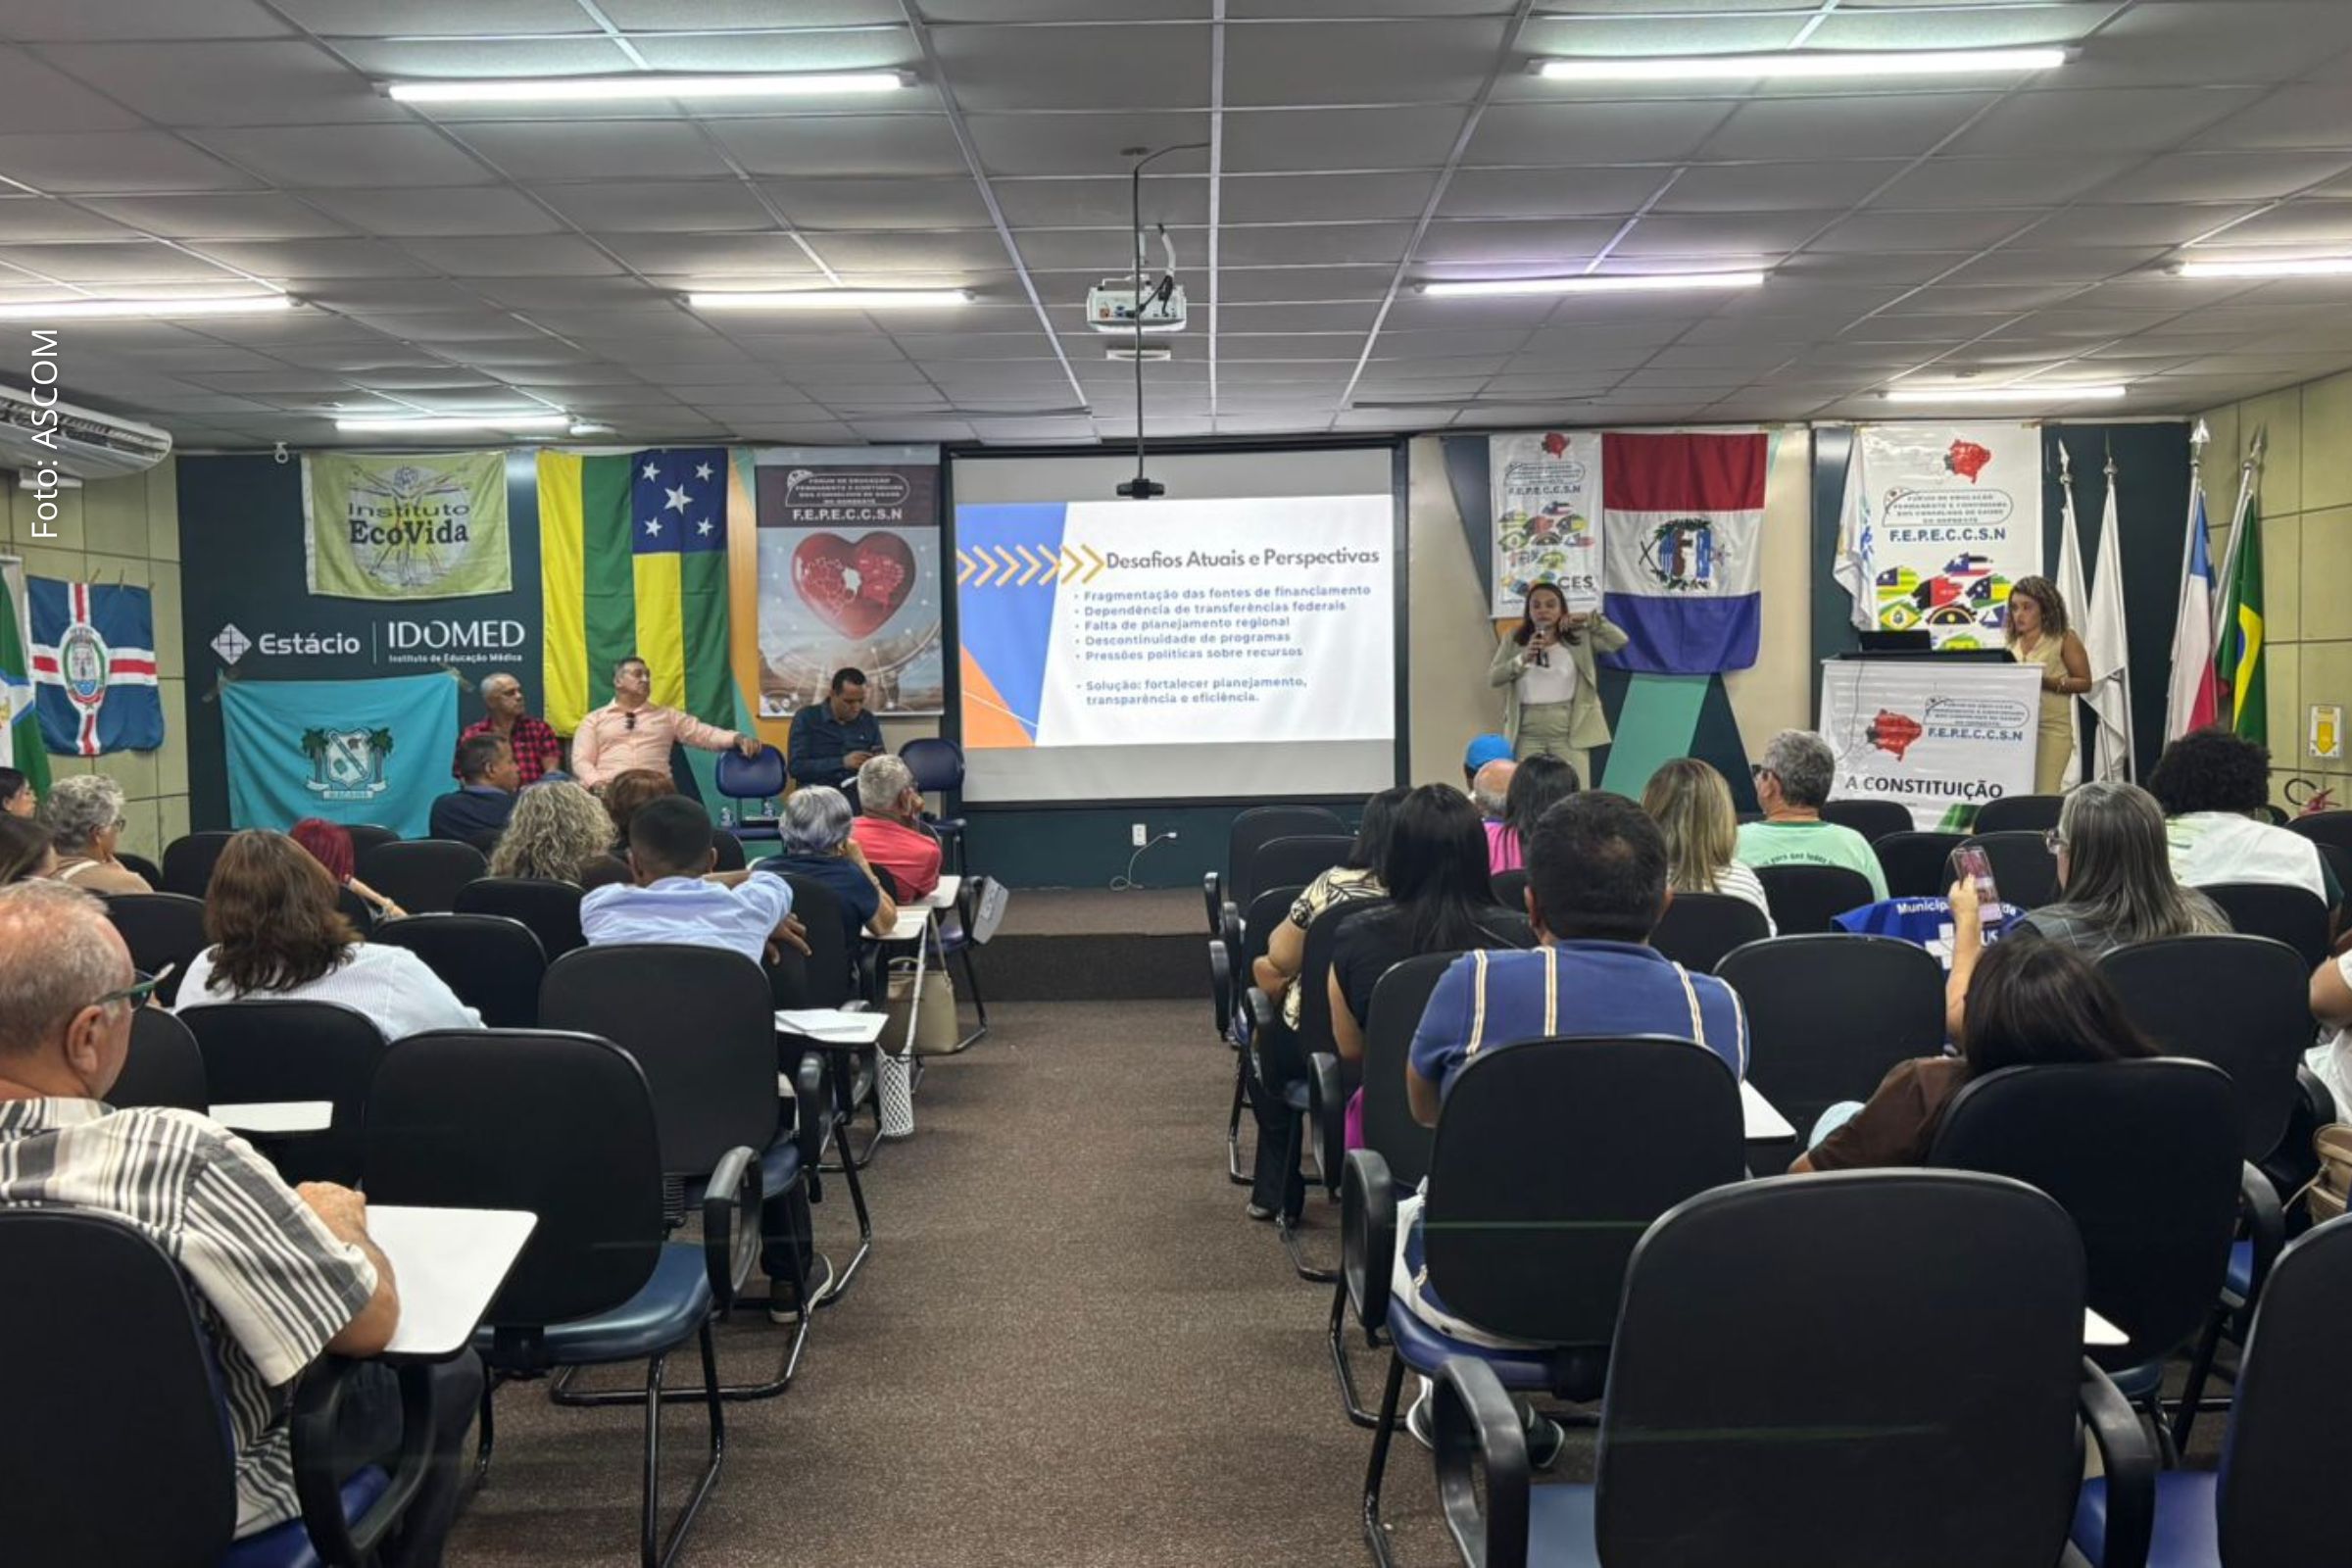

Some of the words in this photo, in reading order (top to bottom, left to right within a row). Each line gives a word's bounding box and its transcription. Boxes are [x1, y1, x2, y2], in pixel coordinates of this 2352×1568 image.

[348, 502, 470, 517] Instituto
[349, 519, 470, 546] EcoVida
[1106, 551, 1183, 569] Desafios
[1186, 550, 1246, 567] Atuais
[1250, 556, 1260, 565] e
[1264, 547, 1380, 569] Perspectivas
[1557, 574, 1593, 589] CES
[1084, 590, 1179, 603] Fragmentação
[1182, 588, 1205, 600] das
[1209, 587, 1251, 599] fontes
[1254, 587, 1271, 598] de
[1274, 585, 1371, 597] financiamento
[1084, 605, 1170, 617] Dependência
[1174, 605, 1191, 614] de
[1195, 602, 1290, 613] transferências
[1293, 601, 1347, 612] federais
[1085, 620, 1117, 631] Falta
[1121, 620, 1137, 630] de
[1141, 618, 1232, 631] planejamento
[1236, 616, 1290, 629] regional
[388, 619, 525, 649] IDOMED
[1085, 634, 1197, 646] Descontinuidade
[1200, 634, 1216, 644] de
[1220, 632, 1291, 644] programas
[259, 633, 361, 655] Estácio
[430, 654, 441, 662] de
[1206, 648, 1244, 659] sobre
[1247, 648, 1303, 658] recursos
[1145, 677, 1208, 690] fortalecer
[1212, 676, 1307, 690] planejamento,
[1180, 695, 1189, 704] e
[1845, 775, 1858, 790] A
[1864, 777, 2002, 800] CONSTITUIÇÃO
[1896, 900, 1949, 916] Municip
